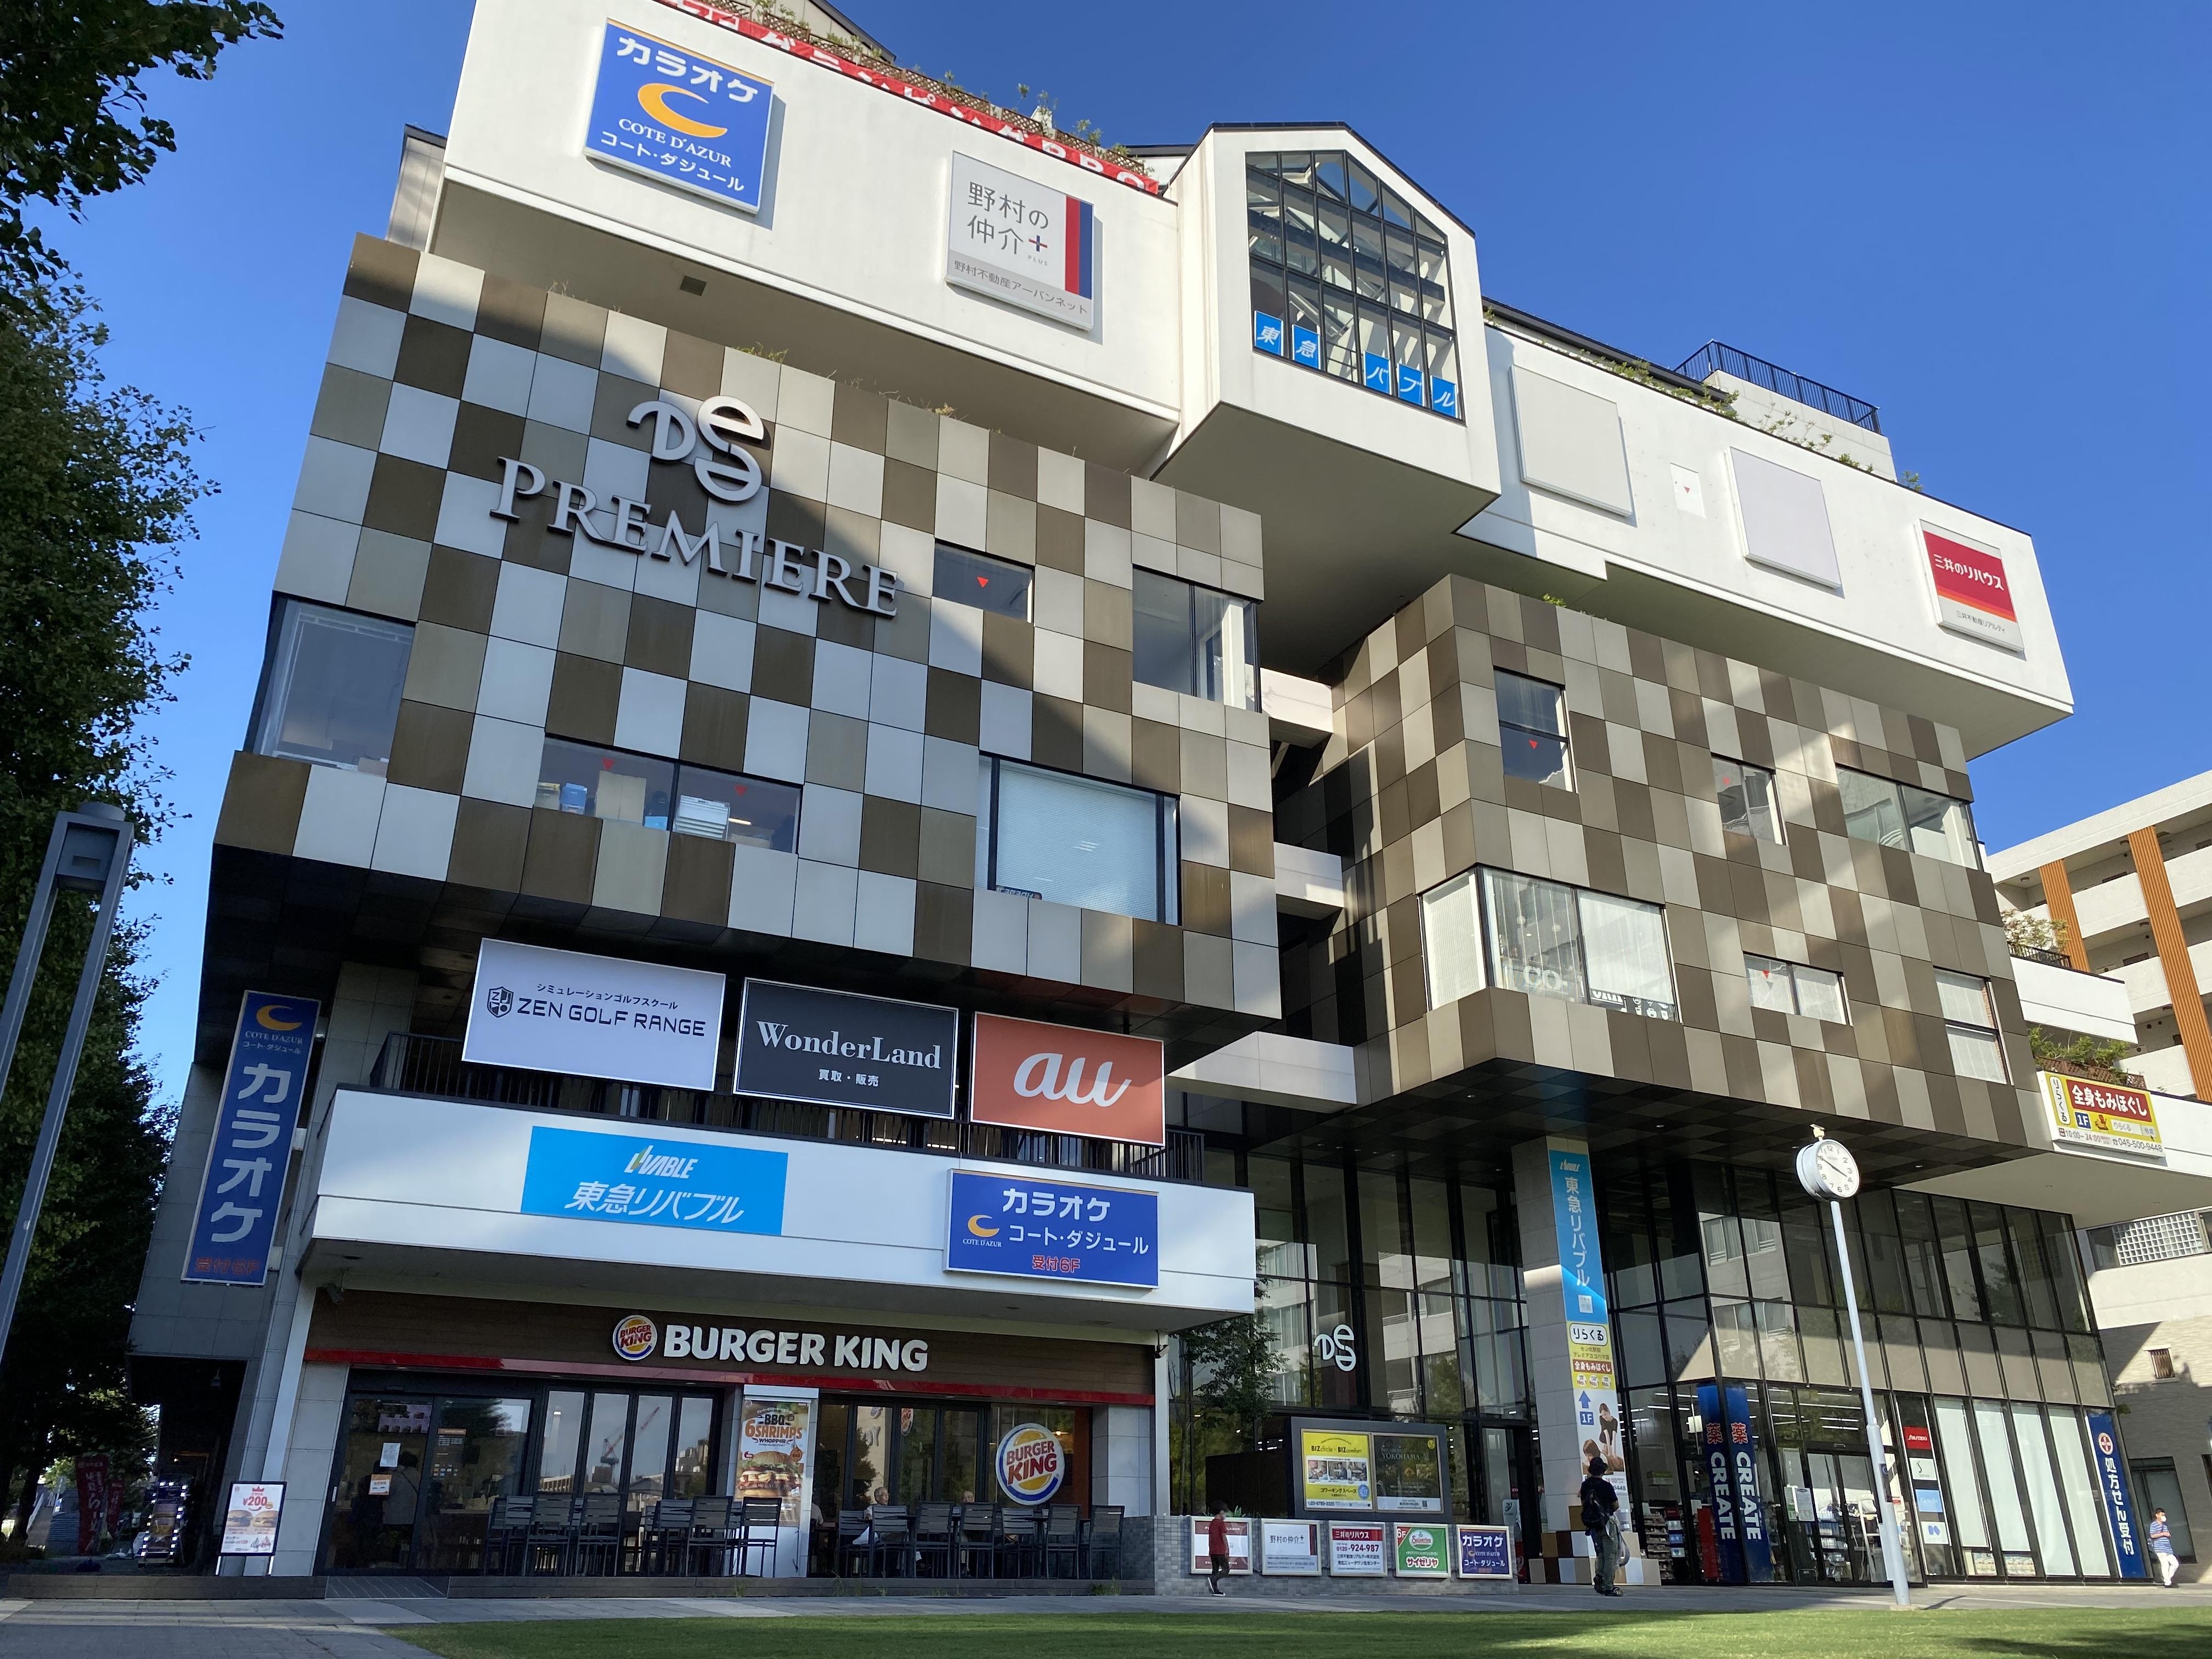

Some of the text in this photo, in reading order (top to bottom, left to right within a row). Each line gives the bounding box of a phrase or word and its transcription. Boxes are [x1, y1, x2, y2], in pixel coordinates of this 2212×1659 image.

[617, 37, 758, 103] カラオケ
[618, 119, 666, 144] COTE
[601, 131, 744, 192] コート・ダジュール
[968, 182, 1048, 229] 野村の
[1028, 255, 1048, 267] PLUS
[953, 259, 1088, 314] 野村不動産アーバンネット
[490, 456, 899, 619] PREMIERE
[1933, 554, 2005, 591] 三井のリハウス
[537, 983, 678, 1011] シミュレーションゴルフスクール
[517, 997, 706, 1036] ZEN GOLF RANGE
[245, 1030, 270, 1041] COTE
[756, 1020, 941, 1069] WonderLand
[819, 1068, 879, 1087] 買取・販売
[1013, 1052, 1132, 1107] au
[2052, 1079, 2068, 1122] りらくる
[2072, 1084, 2147, 1116] 全身もみほぐし
[2076, 1114, 2089, 1127] 1F
[2113, 1122, 2132, 1132] りらくる
[211, 1062, 291, 1243] カラオケ
[624, 1145, 698, 1179] LIVABLE
[564, 1181, 745, 1224] 東急リバブル
[1002, 1188, 1111, 1222] カラオケ
[962, 1238, 980, 1246] COTE
[1009, 1224, 1149, 1255] コート・ダジュール
[1565, 1177, 1590, 1287] 東急リバブル
[620, 1324, 652, 1348] BURGER KING
[663, 1324, 928, 1372] BURGER KING
[1573, 1328, 1604, 1341] りらくる
[1575, 1361, 1611, 1373] 全身もみほぐし
[764, 1414, 786, 1425] BBQ
[1582, 1413, 1593, 1424] 1F
[1706, 1422, 1723, 1444] 薬
[1731, 1422, 1748, 1444] 薬
[1006, 1440, 1057, 1486] BURGER KING
[1711, 1452, 1736, 1540] CREATE
[1736, 1452, 1762, 1540] CREATE
[2104, 1457, 2135, 1555] 処方せん受付
[1335, 1531, 1370, 1539] 三井のリハウス
[1336, 1544, 1380, 1553] 0120-924-987
[1397, 1528, 1407, 1539] 6F
[1462, 1534, 1504, 1548] カラオケ
[1406, 1556, 1439, 1568] サイゼリヤ
